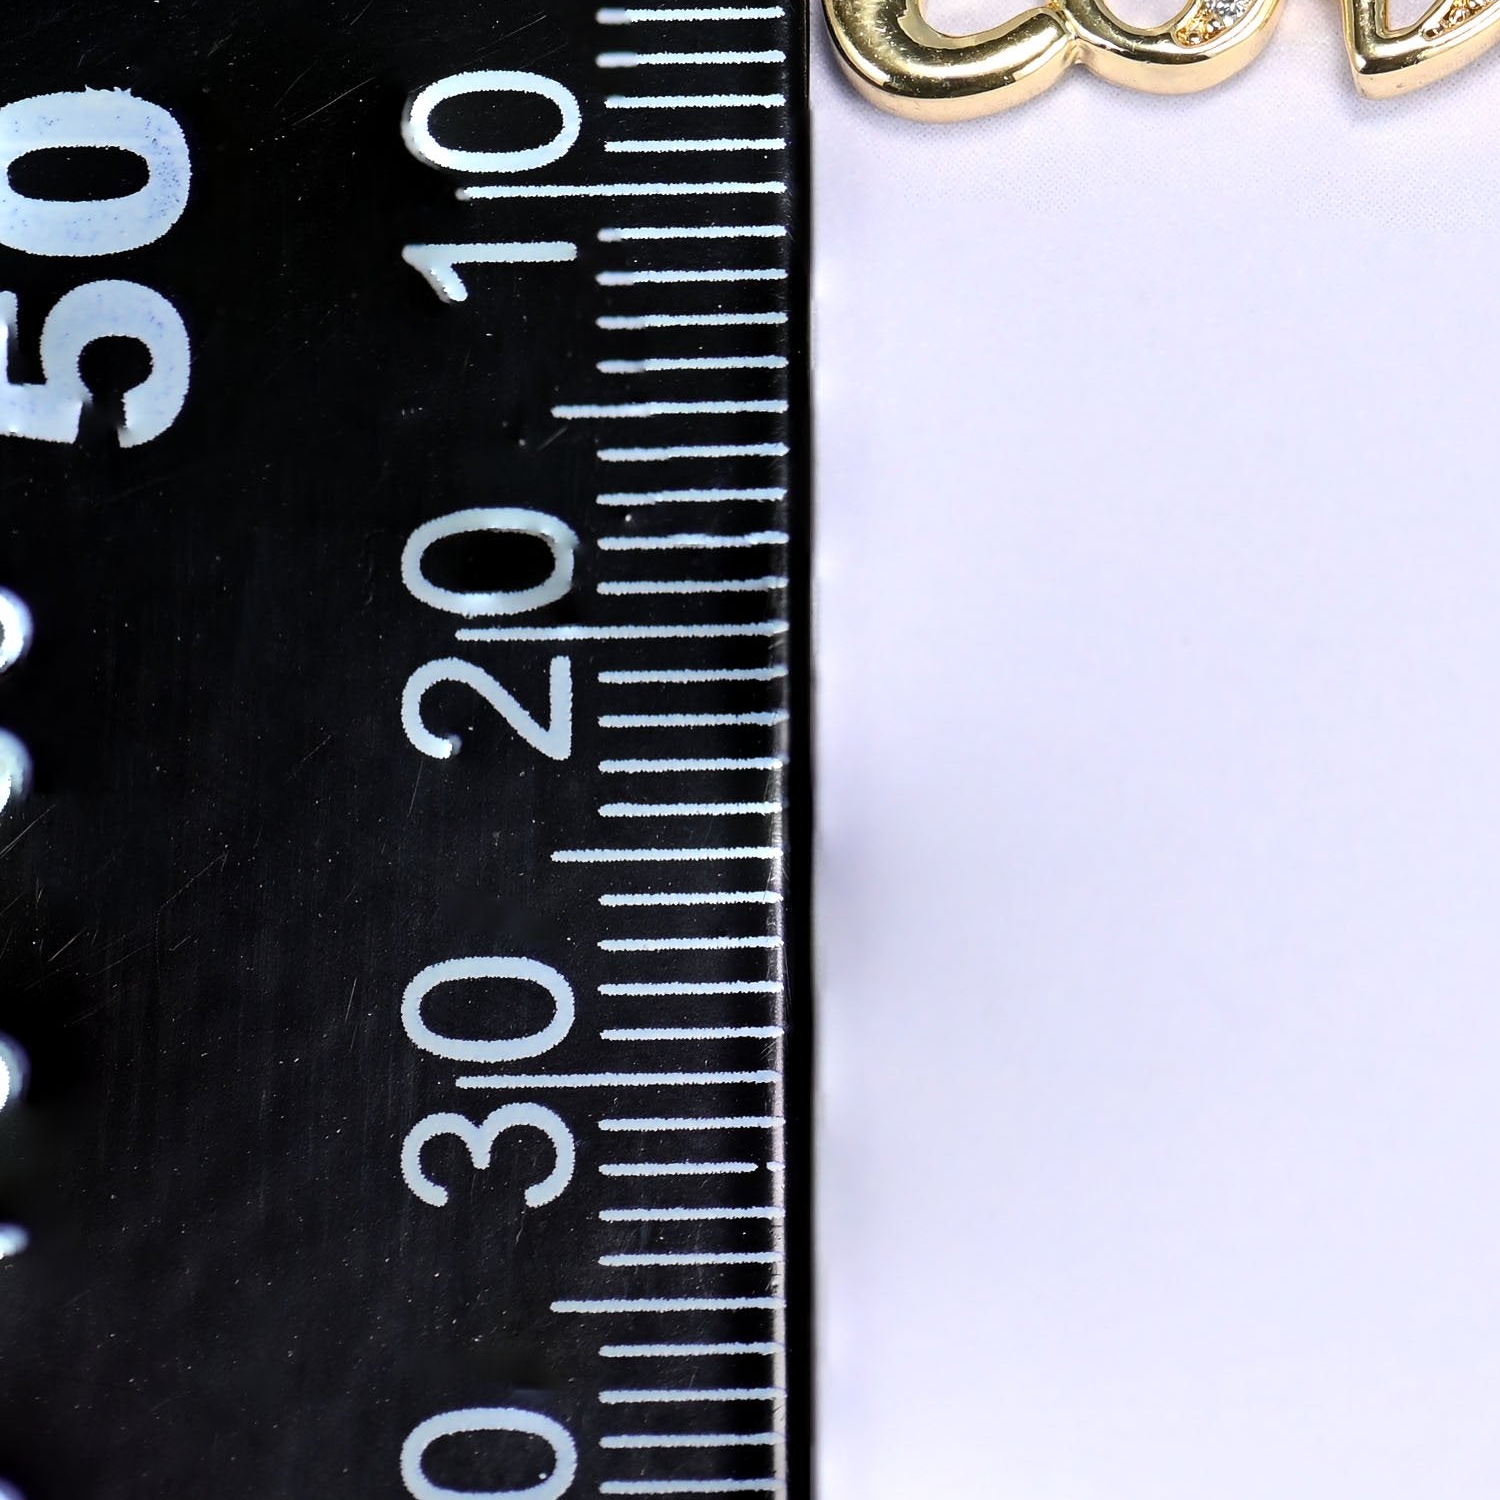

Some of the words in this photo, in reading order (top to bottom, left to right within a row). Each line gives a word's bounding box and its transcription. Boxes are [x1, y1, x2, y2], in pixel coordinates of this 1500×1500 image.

[0, 85, 192, 447] 50
[402, 69, 582, 301] 10
[401, 508, 578, 760] 20
[401, 956, 575, 1208] 30
